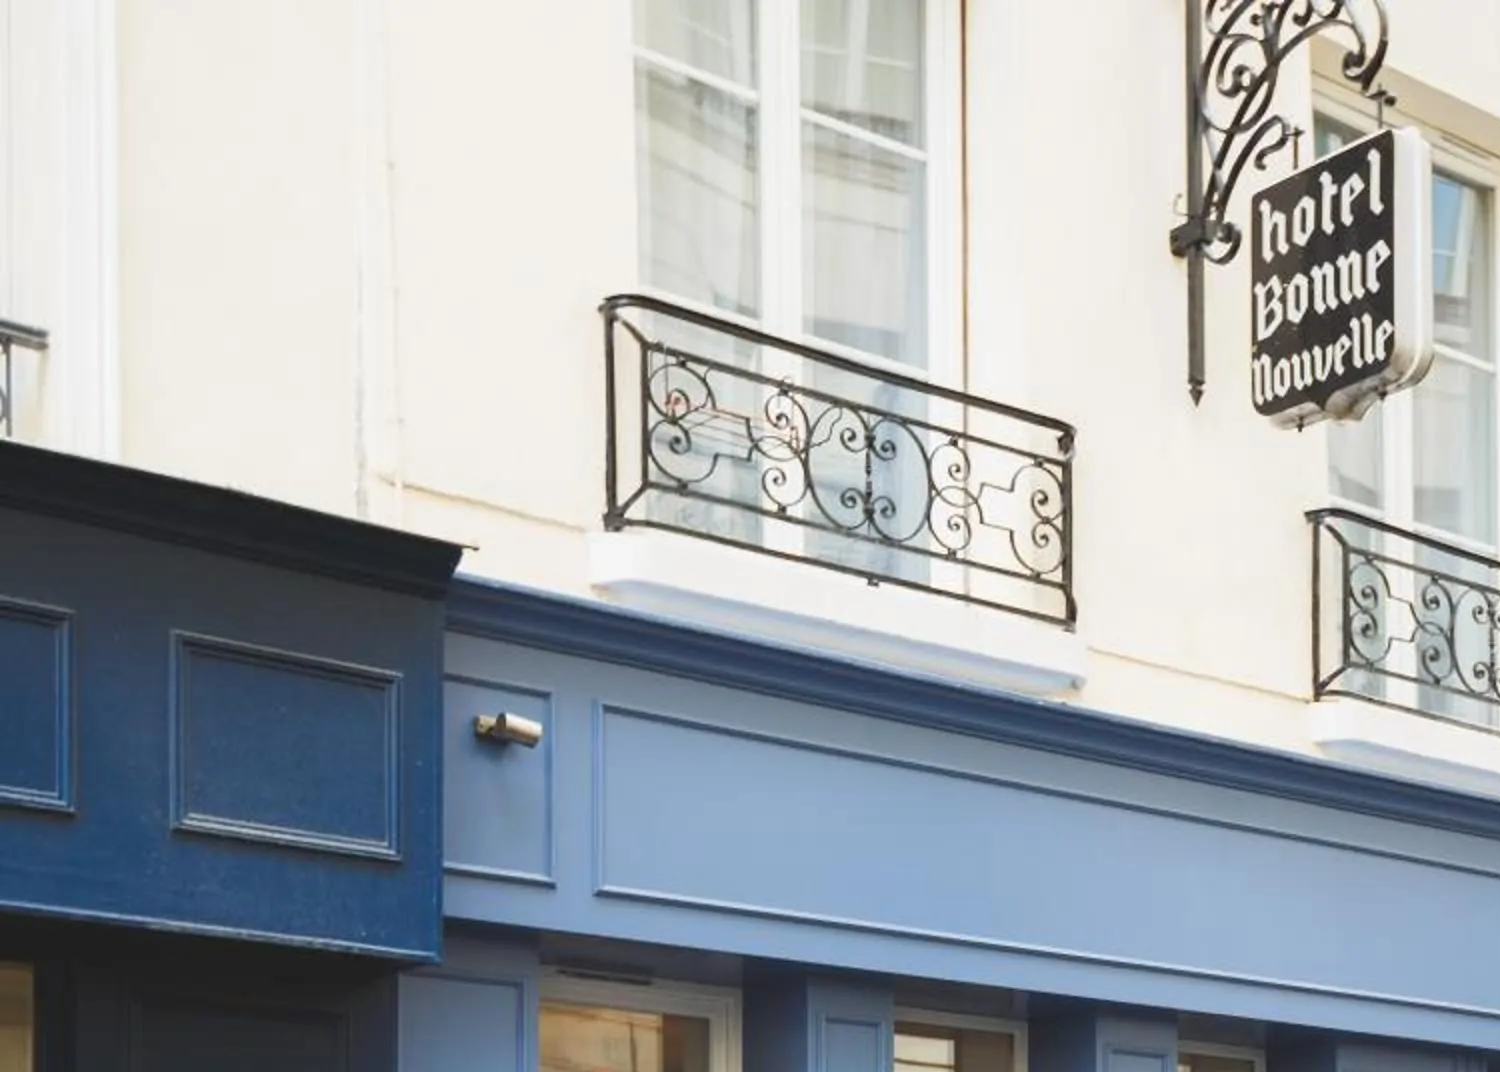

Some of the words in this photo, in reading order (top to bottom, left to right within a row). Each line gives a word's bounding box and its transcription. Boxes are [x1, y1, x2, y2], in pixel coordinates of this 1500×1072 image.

[1258, 147, 1385, 263] hotel
[1253, 238, 1392, 342] Bonne
[1251, 311, 1395, 405] Nouvelle
